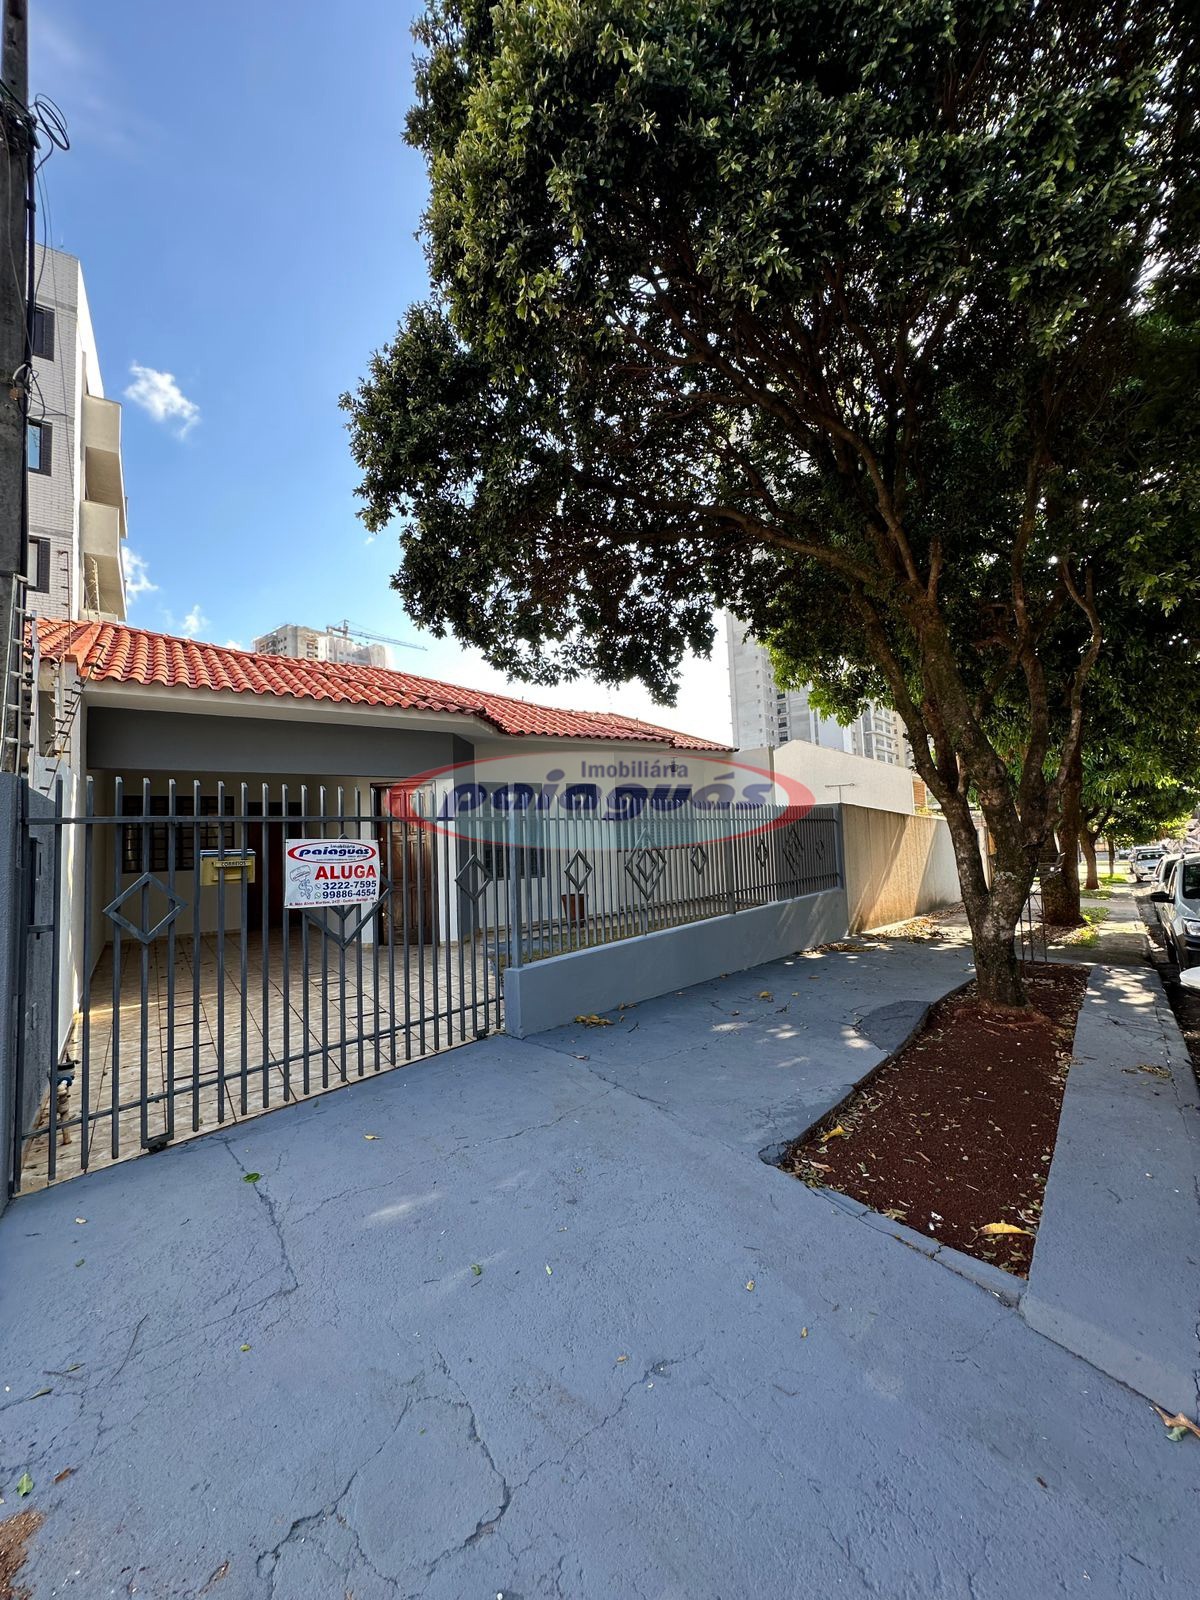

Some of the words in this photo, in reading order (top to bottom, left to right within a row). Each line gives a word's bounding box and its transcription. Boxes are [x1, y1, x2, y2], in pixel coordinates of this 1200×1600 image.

[299, 847, 370, 857] paiaguás
[315, 865, 377, 880] ALUGA
[322, 880, 377, 890] 3222-7595
[322, 888, 376, 899] 99886-4554
